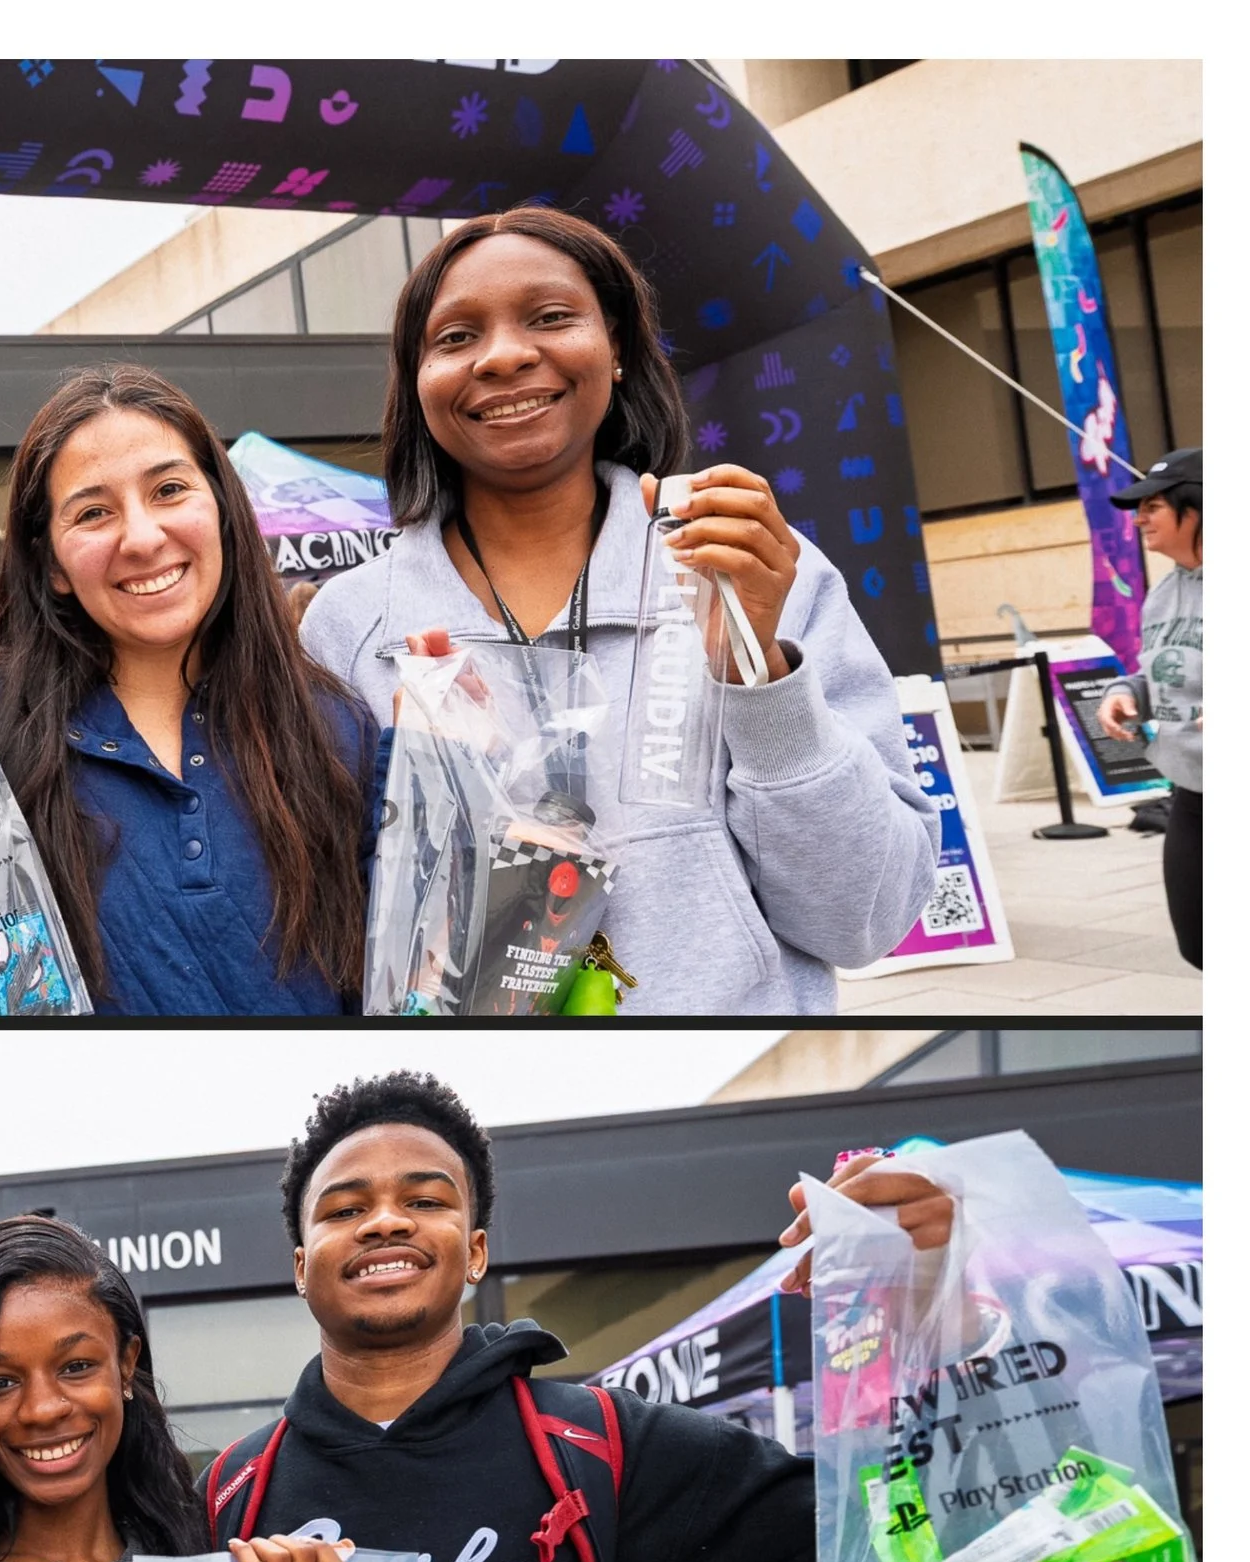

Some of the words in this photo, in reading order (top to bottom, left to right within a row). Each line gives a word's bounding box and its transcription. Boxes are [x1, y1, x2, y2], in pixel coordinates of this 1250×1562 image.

[276, 527, 404, 573] ACING
[647, 585, 698, 727] LIQUID
[903, 723, 924, 742] 5,
[506, 944, 552, 965] FINDING
[554, 953, 571, 968] THE
[514, 963, 558, 980] FASTEST
[889, 1340, 1067, 1435] EWIRED
[881, 1415, 963, 1485] EST
[215, 1466, 255, 1508] ARKANSA
[939, 1460, 1093, 1514] PlayStation
